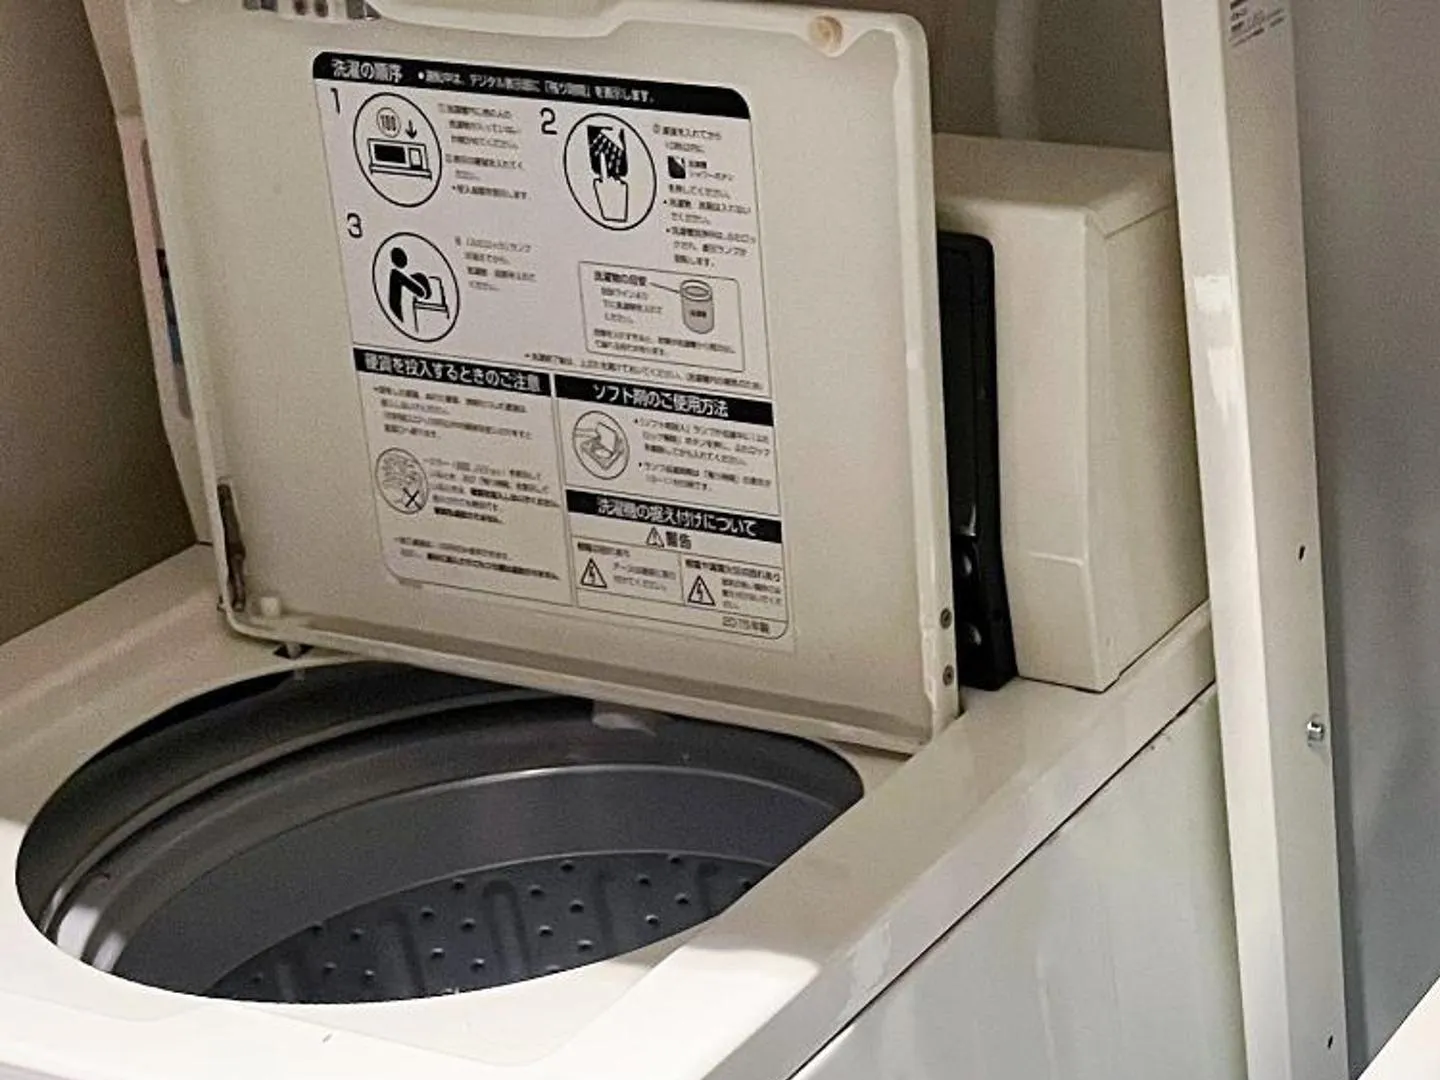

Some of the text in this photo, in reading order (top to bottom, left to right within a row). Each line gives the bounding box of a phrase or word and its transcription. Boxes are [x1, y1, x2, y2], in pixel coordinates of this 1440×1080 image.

[330, 88, 340, 114] 1
[539, 107, 557, 135] 2
[346, 212, 363, 239] 3
